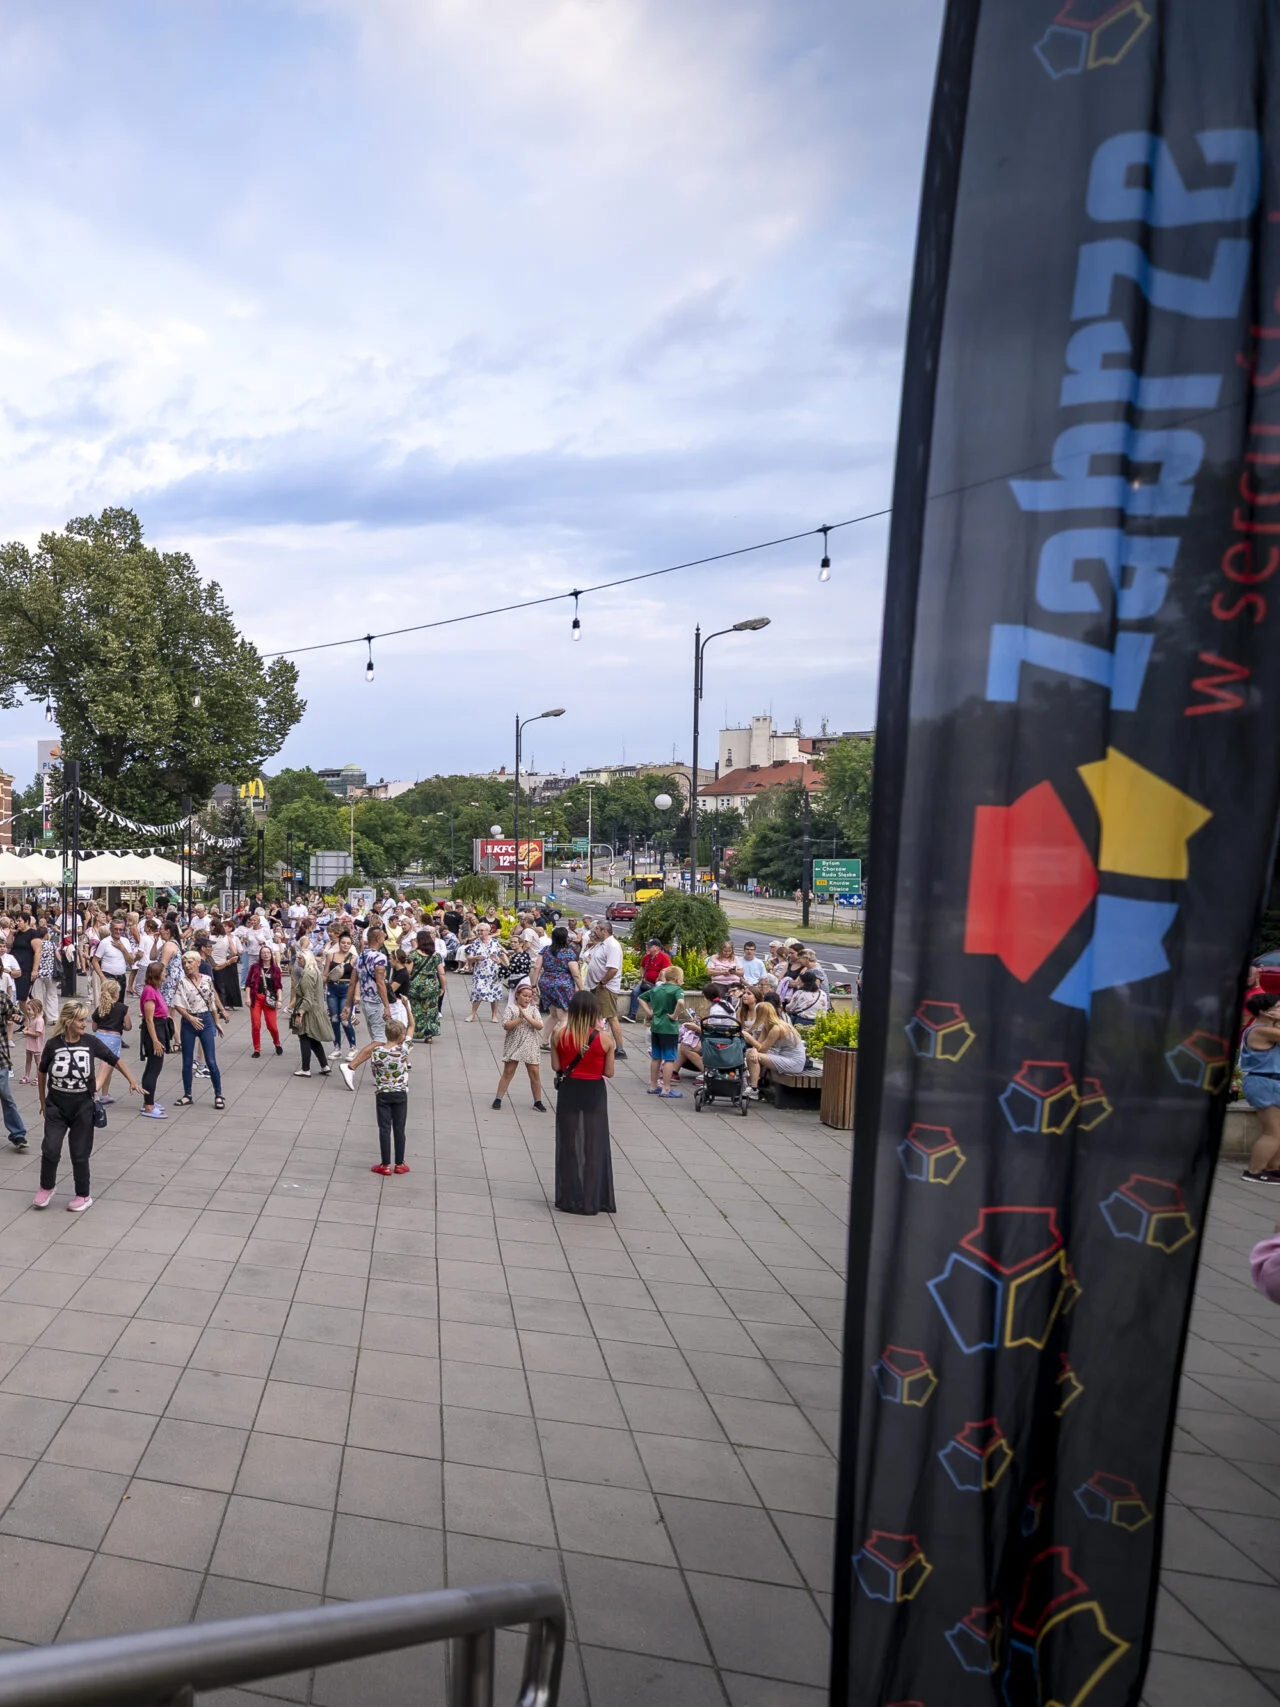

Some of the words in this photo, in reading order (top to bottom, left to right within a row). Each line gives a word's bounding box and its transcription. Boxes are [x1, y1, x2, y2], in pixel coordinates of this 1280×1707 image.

[985, 128, 1261, 711] Zabrze
[1184, 651, 1250, 718] w
[42, 762, 62, 770] PLT
[493, 845, 516, 853] KFC
[51, 1050, 90, 1079] 89
